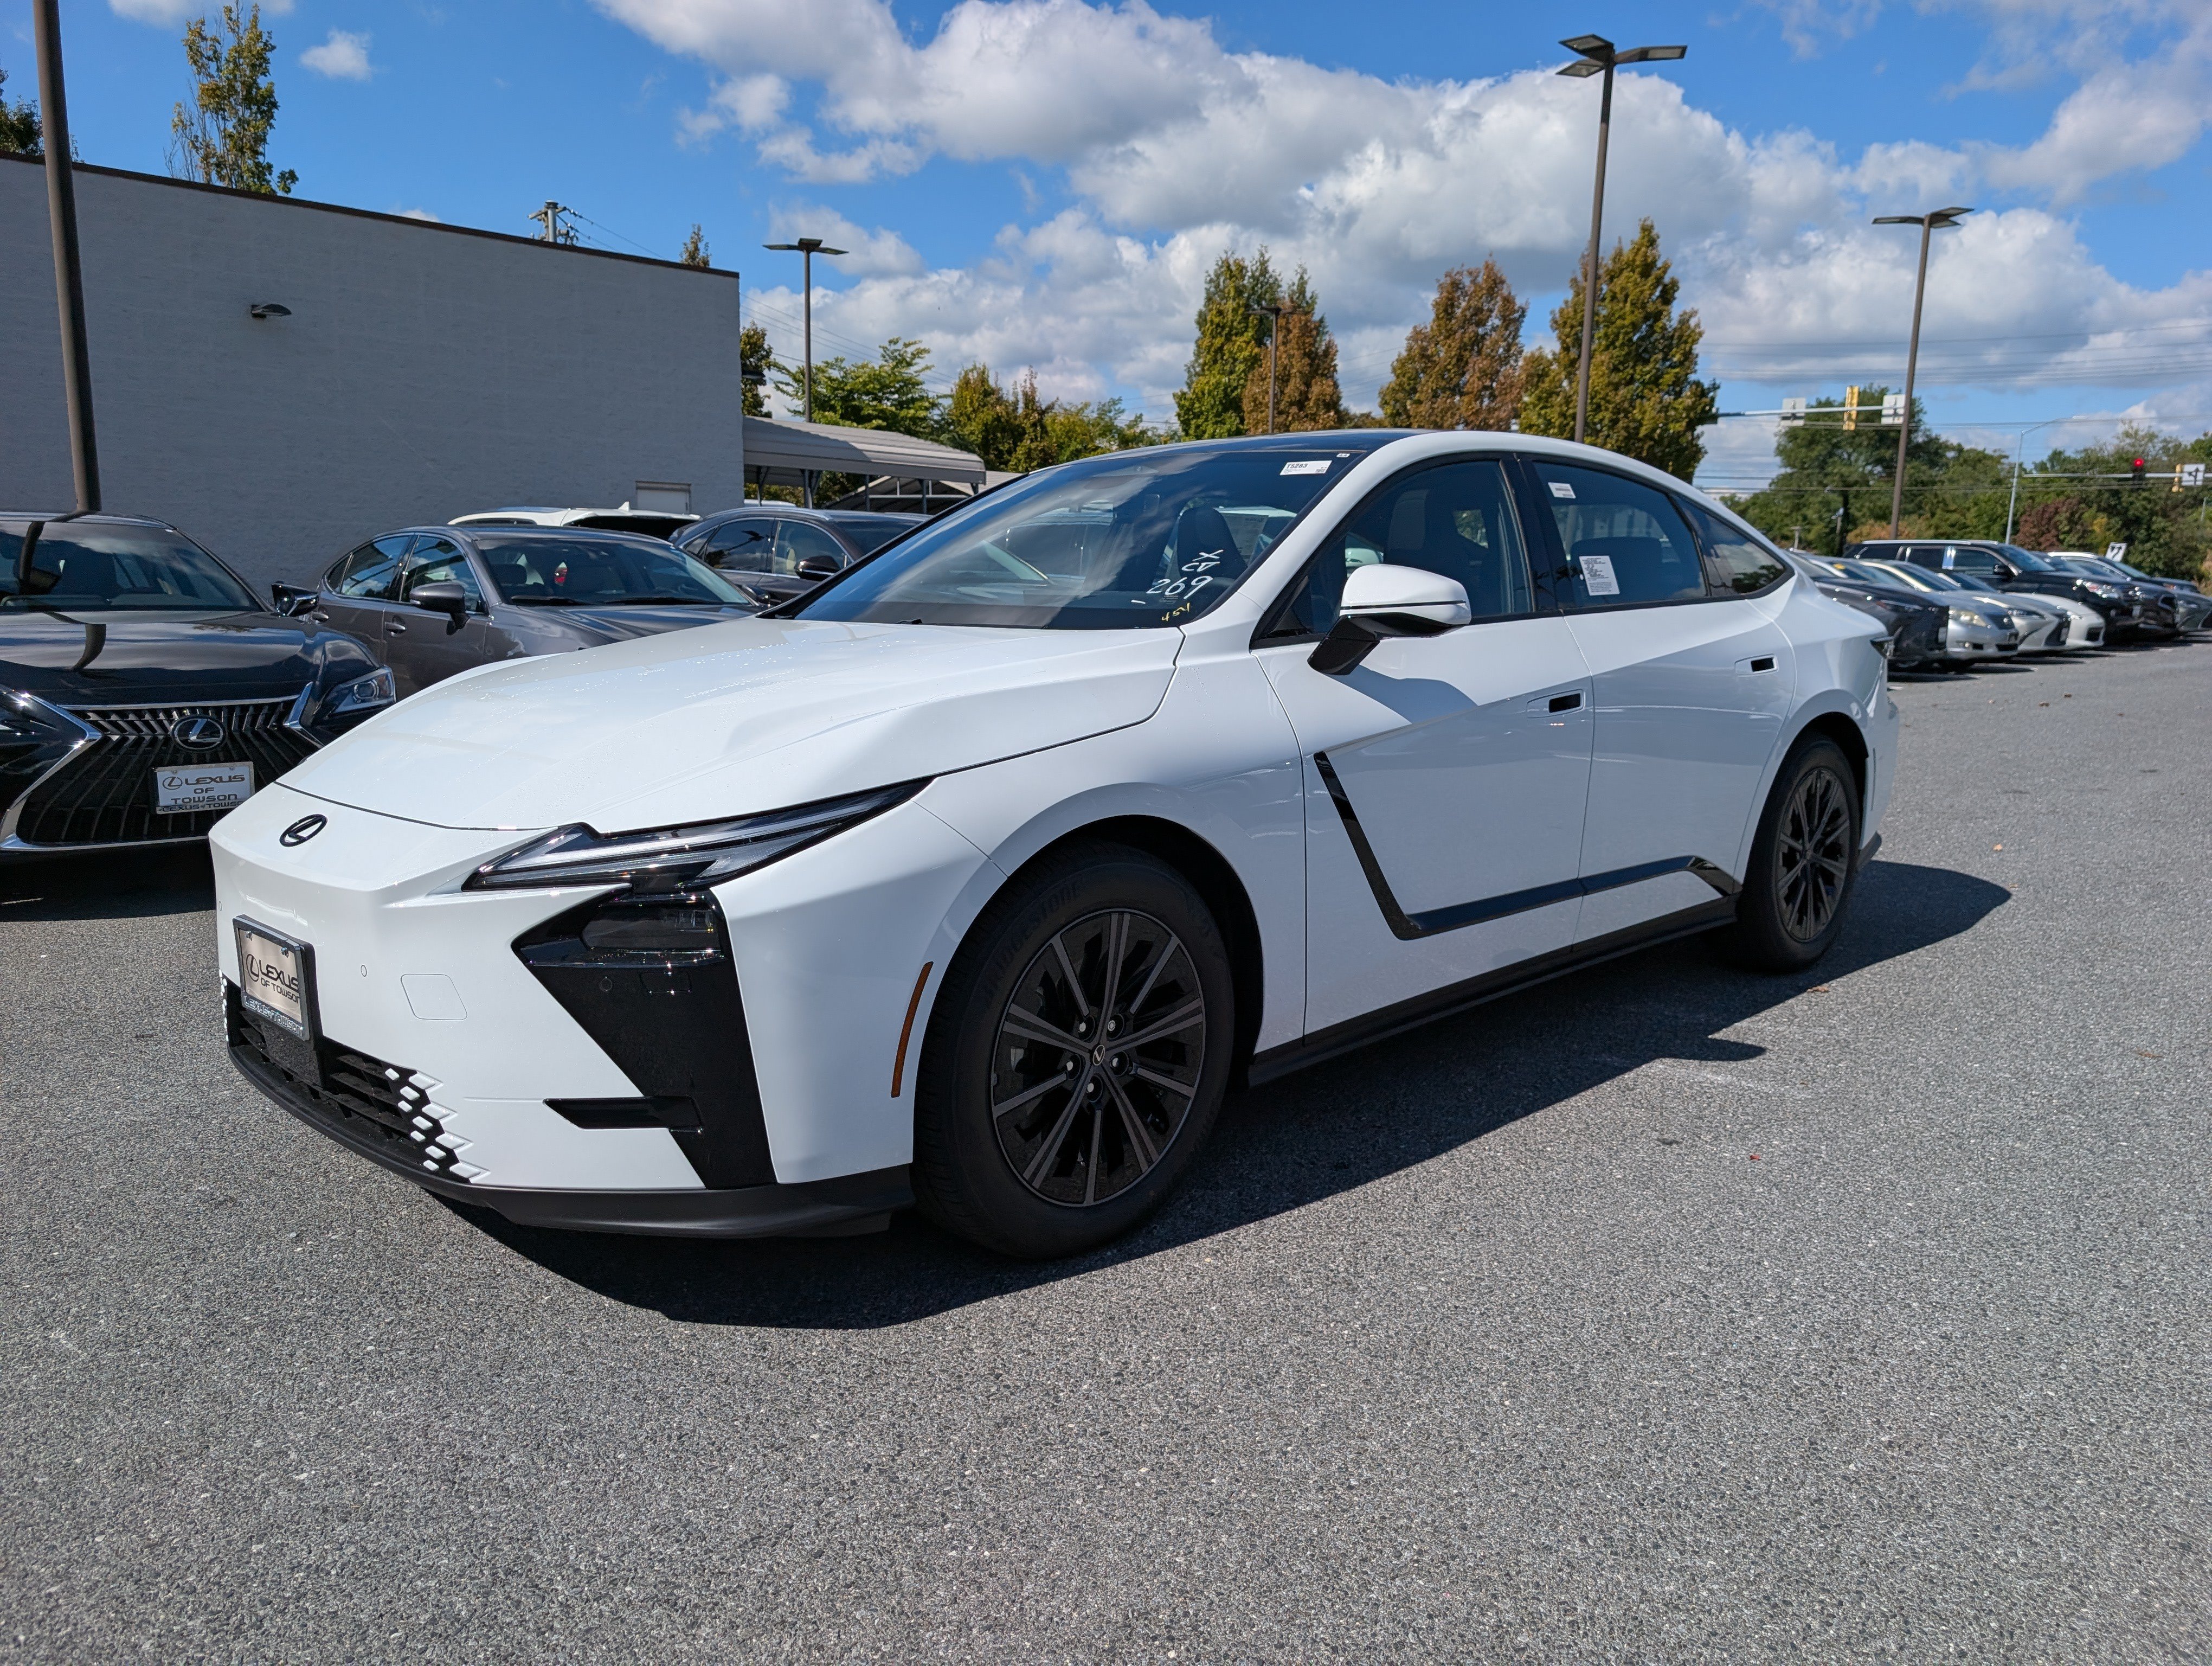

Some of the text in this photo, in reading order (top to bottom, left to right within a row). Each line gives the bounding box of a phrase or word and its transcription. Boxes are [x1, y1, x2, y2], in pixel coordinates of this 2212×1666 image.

[1146, 575, 1213, 599] 269
[185, 774, 245, 786] LEXUS
[170, 794, 237, 804] TOWSON
[259, 959, 299, 993] LEXUS
[260, 977, 271, 988] OF
[243, 995, 269, 1017] LEXUS
